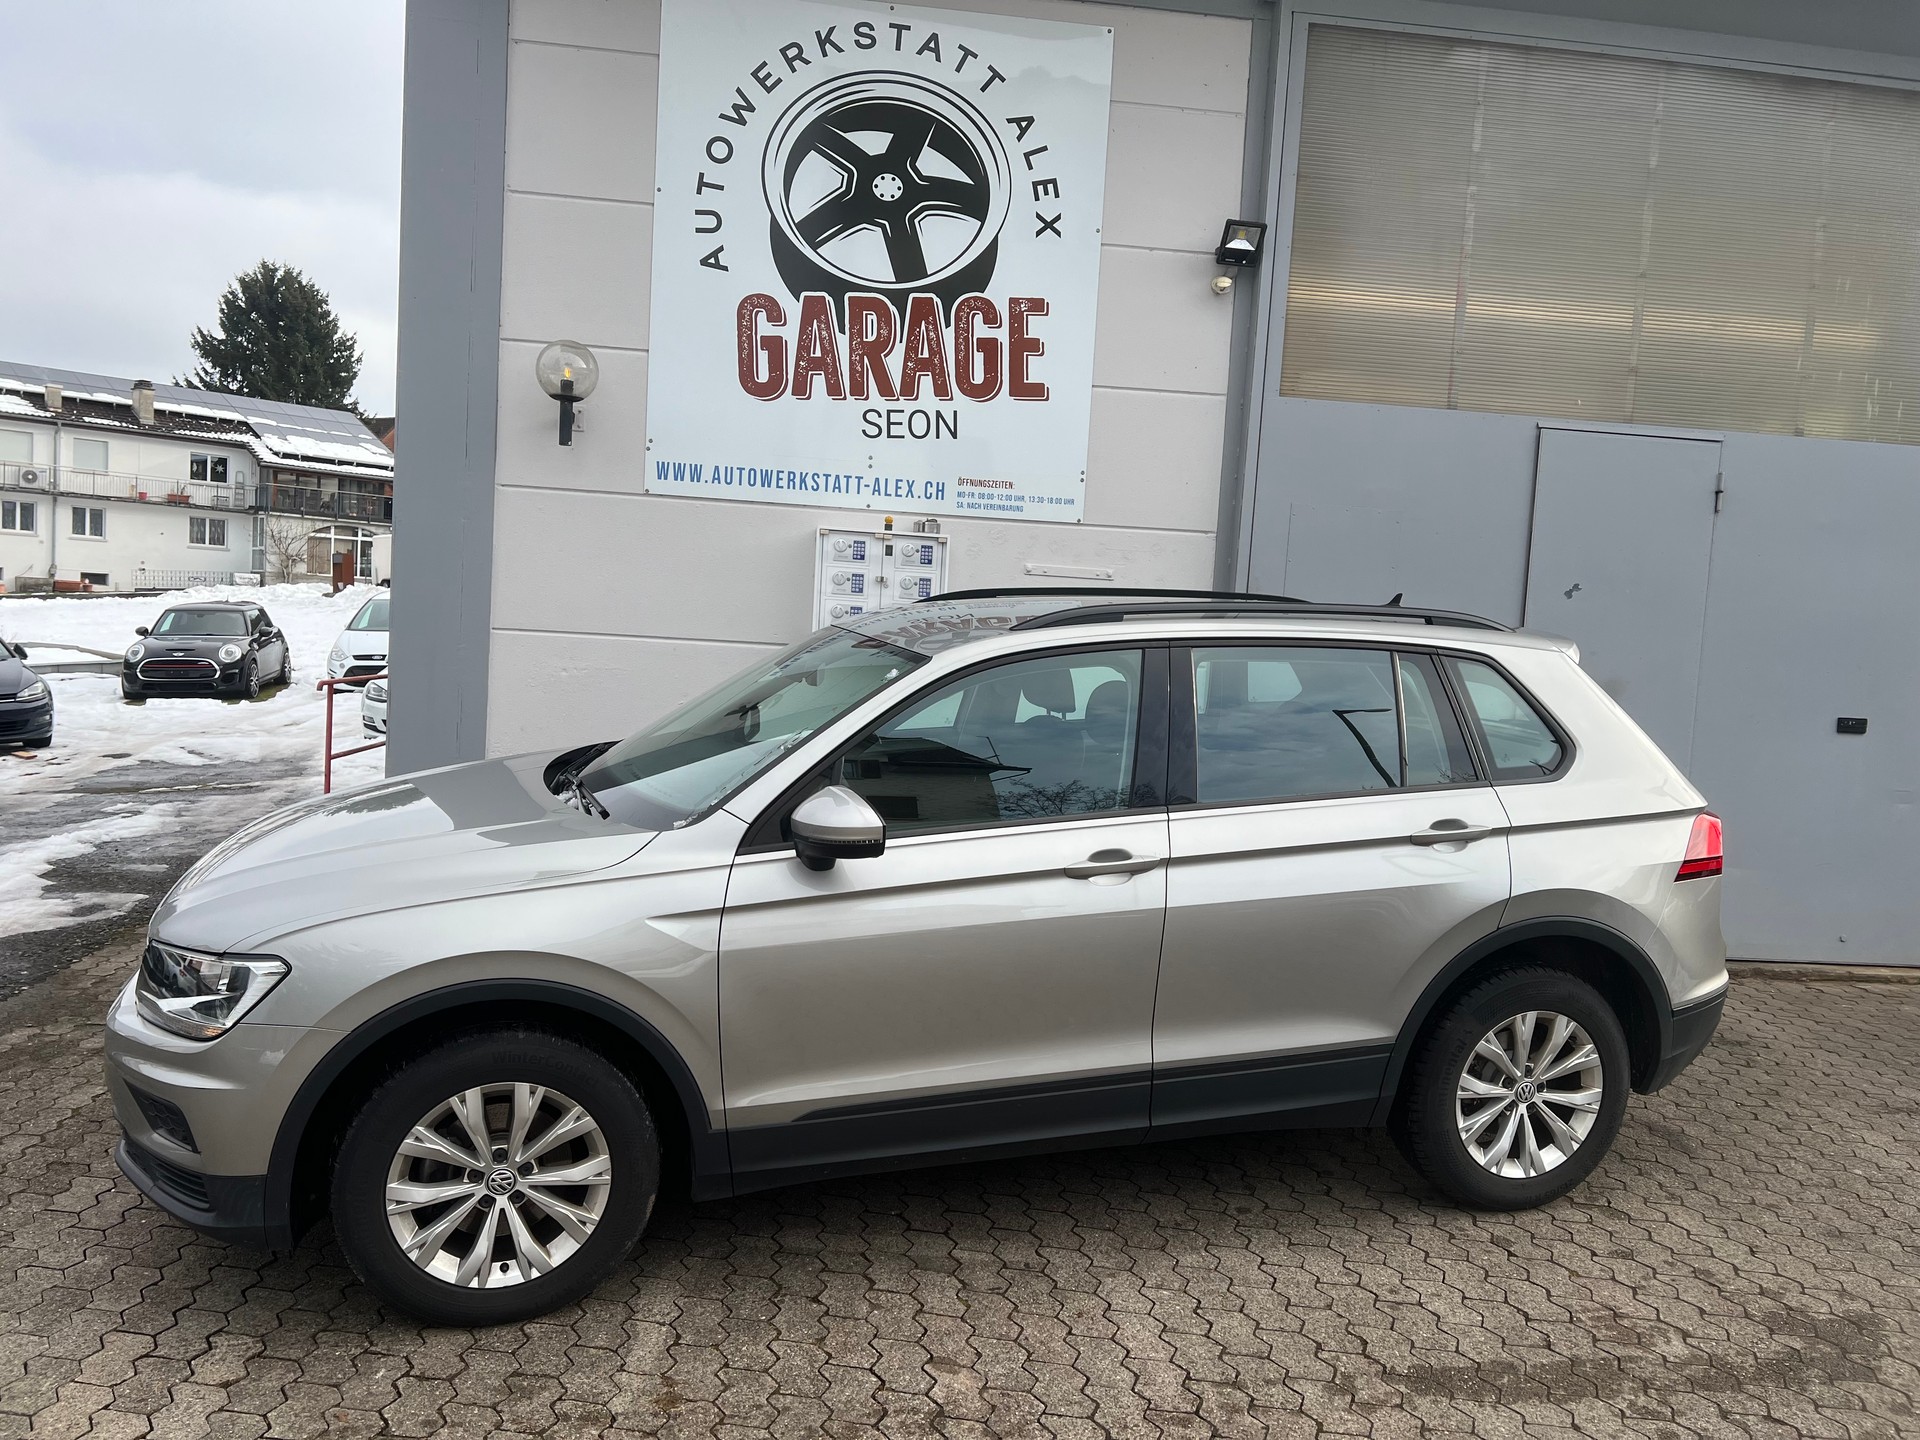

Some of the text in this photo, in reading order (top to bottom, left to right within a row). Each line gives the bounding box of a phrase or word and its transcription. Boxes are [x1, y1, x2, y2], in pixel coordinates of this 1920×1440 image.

[694, 21, 1062, 273] AUTOWERKSTATT ALEX
[736, 292, 1050, 402] GARAGE
[861, 408, 959, 440] SEON
[655, 460, 946, 501] WWW.AUTOWERKSTATT-ALEX.CH
